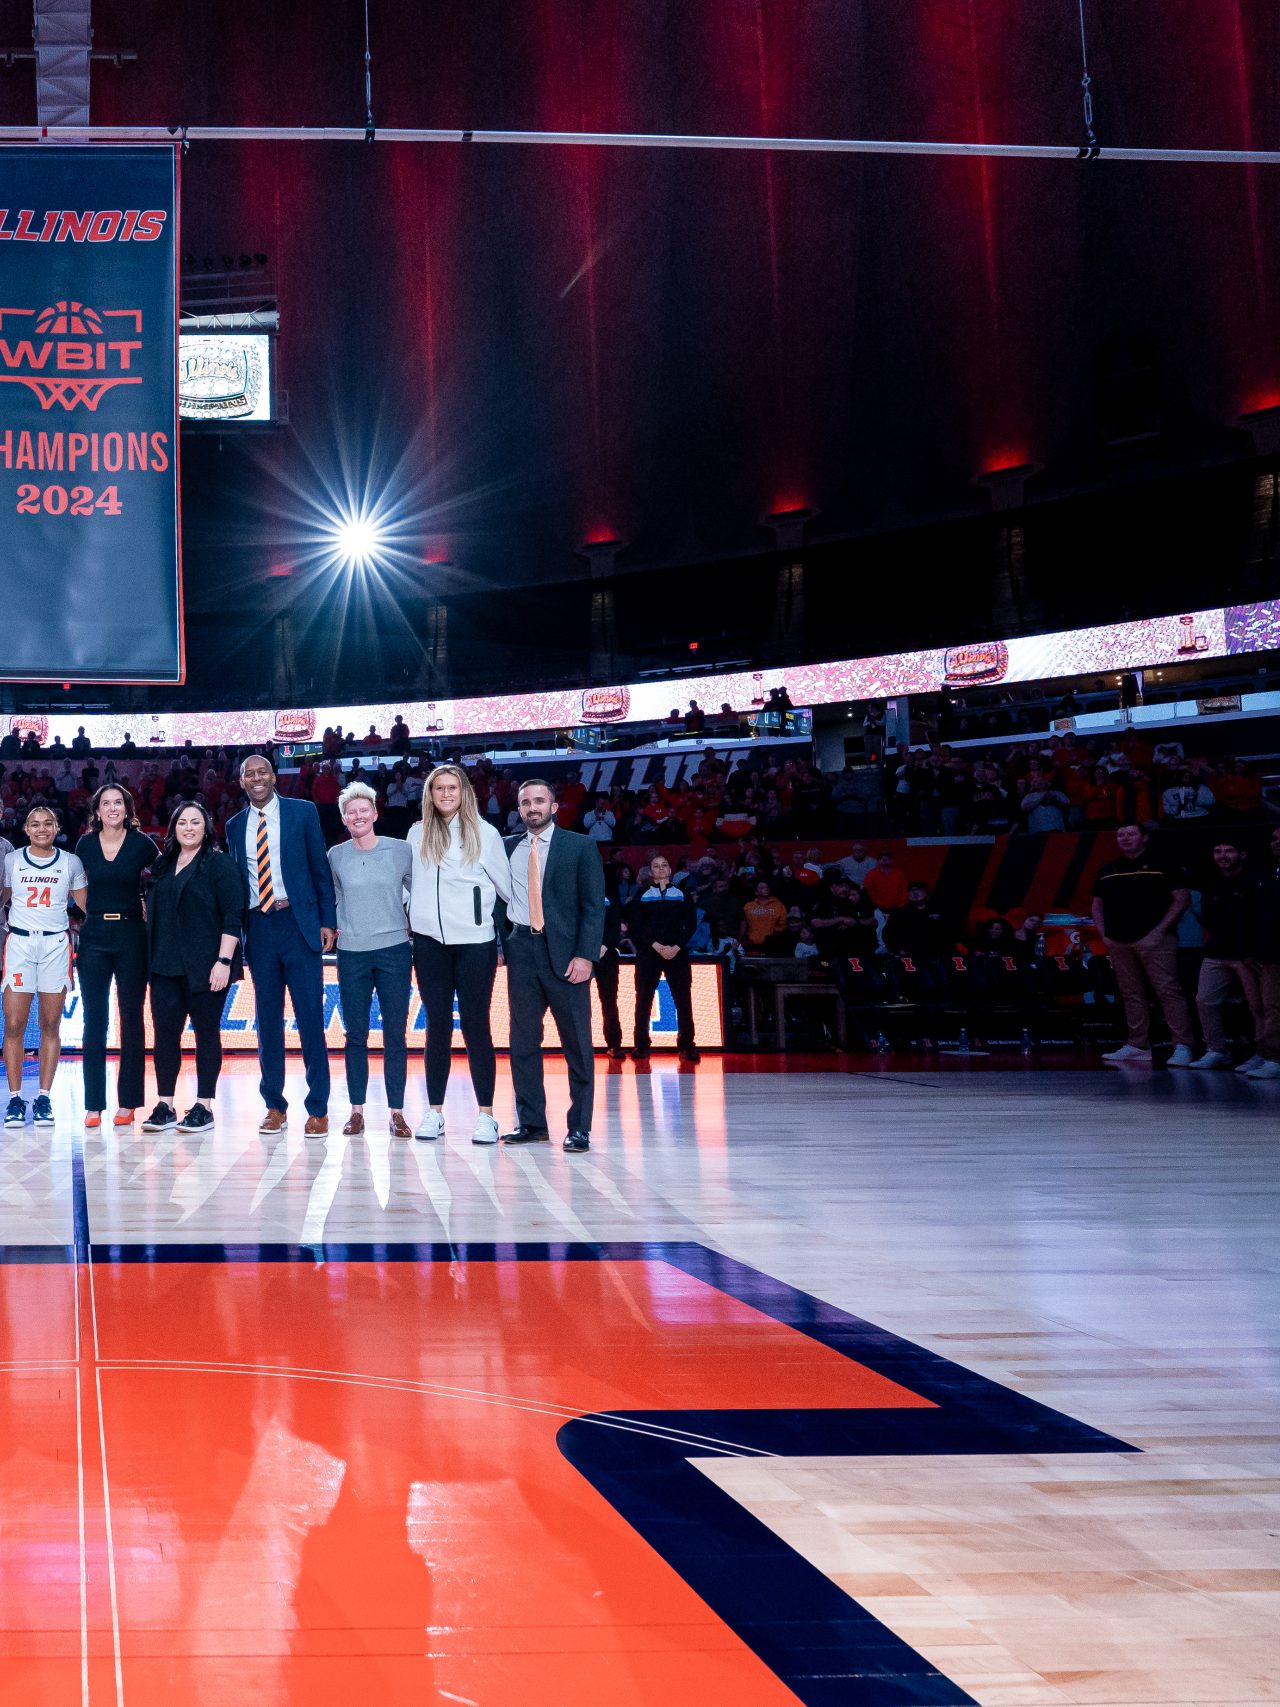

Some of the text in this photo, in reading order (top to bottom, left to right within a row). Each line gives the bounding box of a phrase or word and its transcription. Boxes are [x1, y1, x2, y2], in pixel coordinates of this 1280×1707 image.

[16, 484, 123, 516] 2024
[20, 876, 59, 884] ILLINOIS
[26, 887, 51, 908] 24
